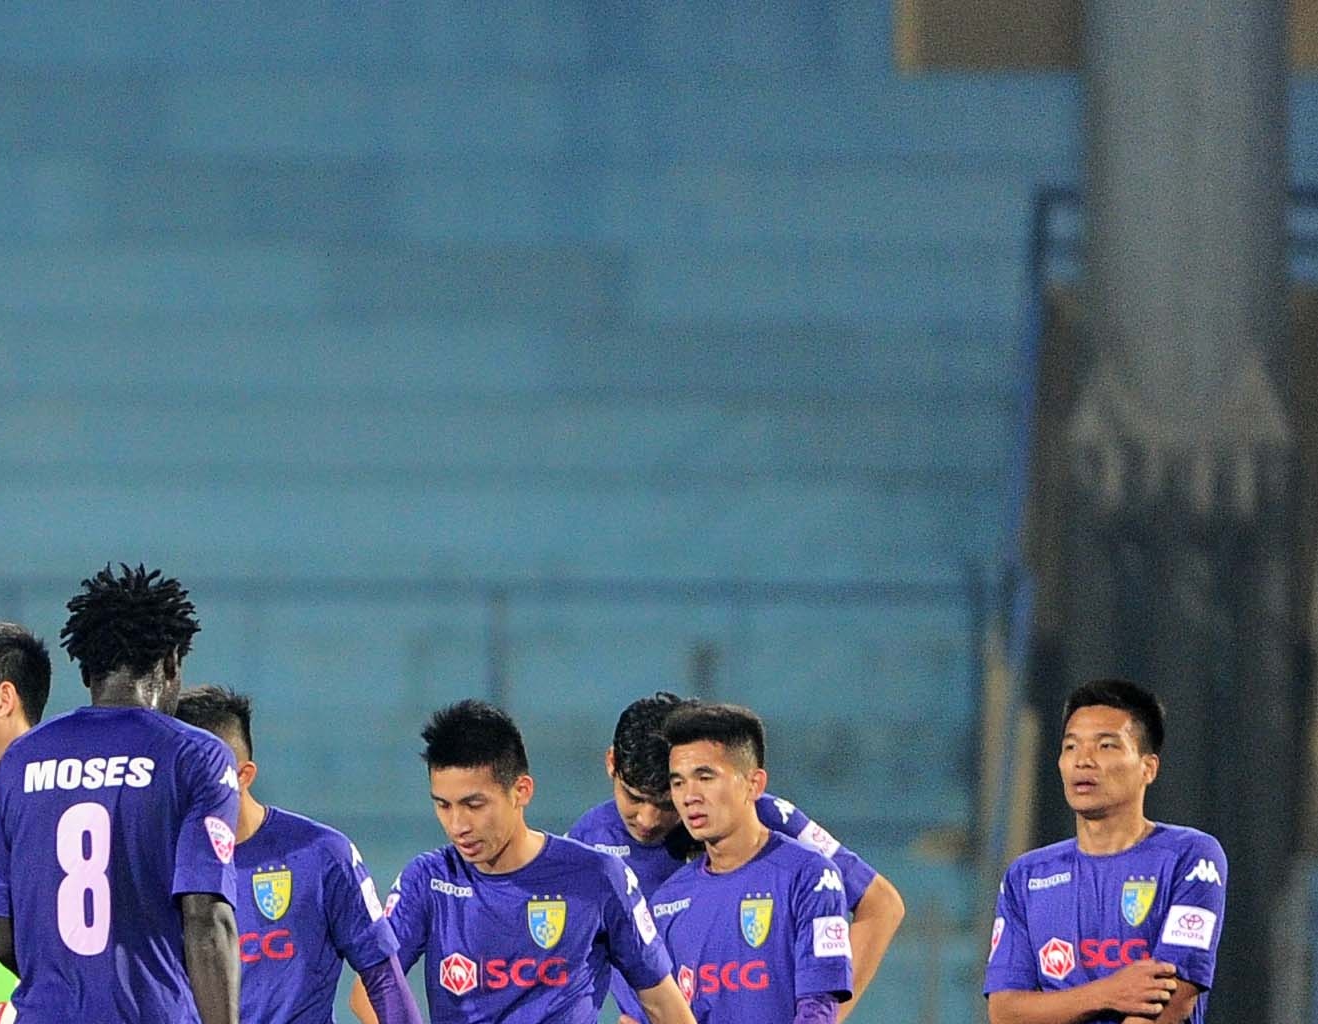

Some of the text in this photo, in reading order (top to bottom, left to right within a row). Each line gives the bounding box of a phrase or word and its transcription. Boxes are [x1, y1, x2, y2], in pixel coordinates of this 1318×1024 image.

[24, 756, 155, 793] MOSES
[57, 802, 111, 956] 8
[237, 929, 294, 962] CG
[486, 957, 569, 989] SCG
[699, 961, 769, 993] SCG
